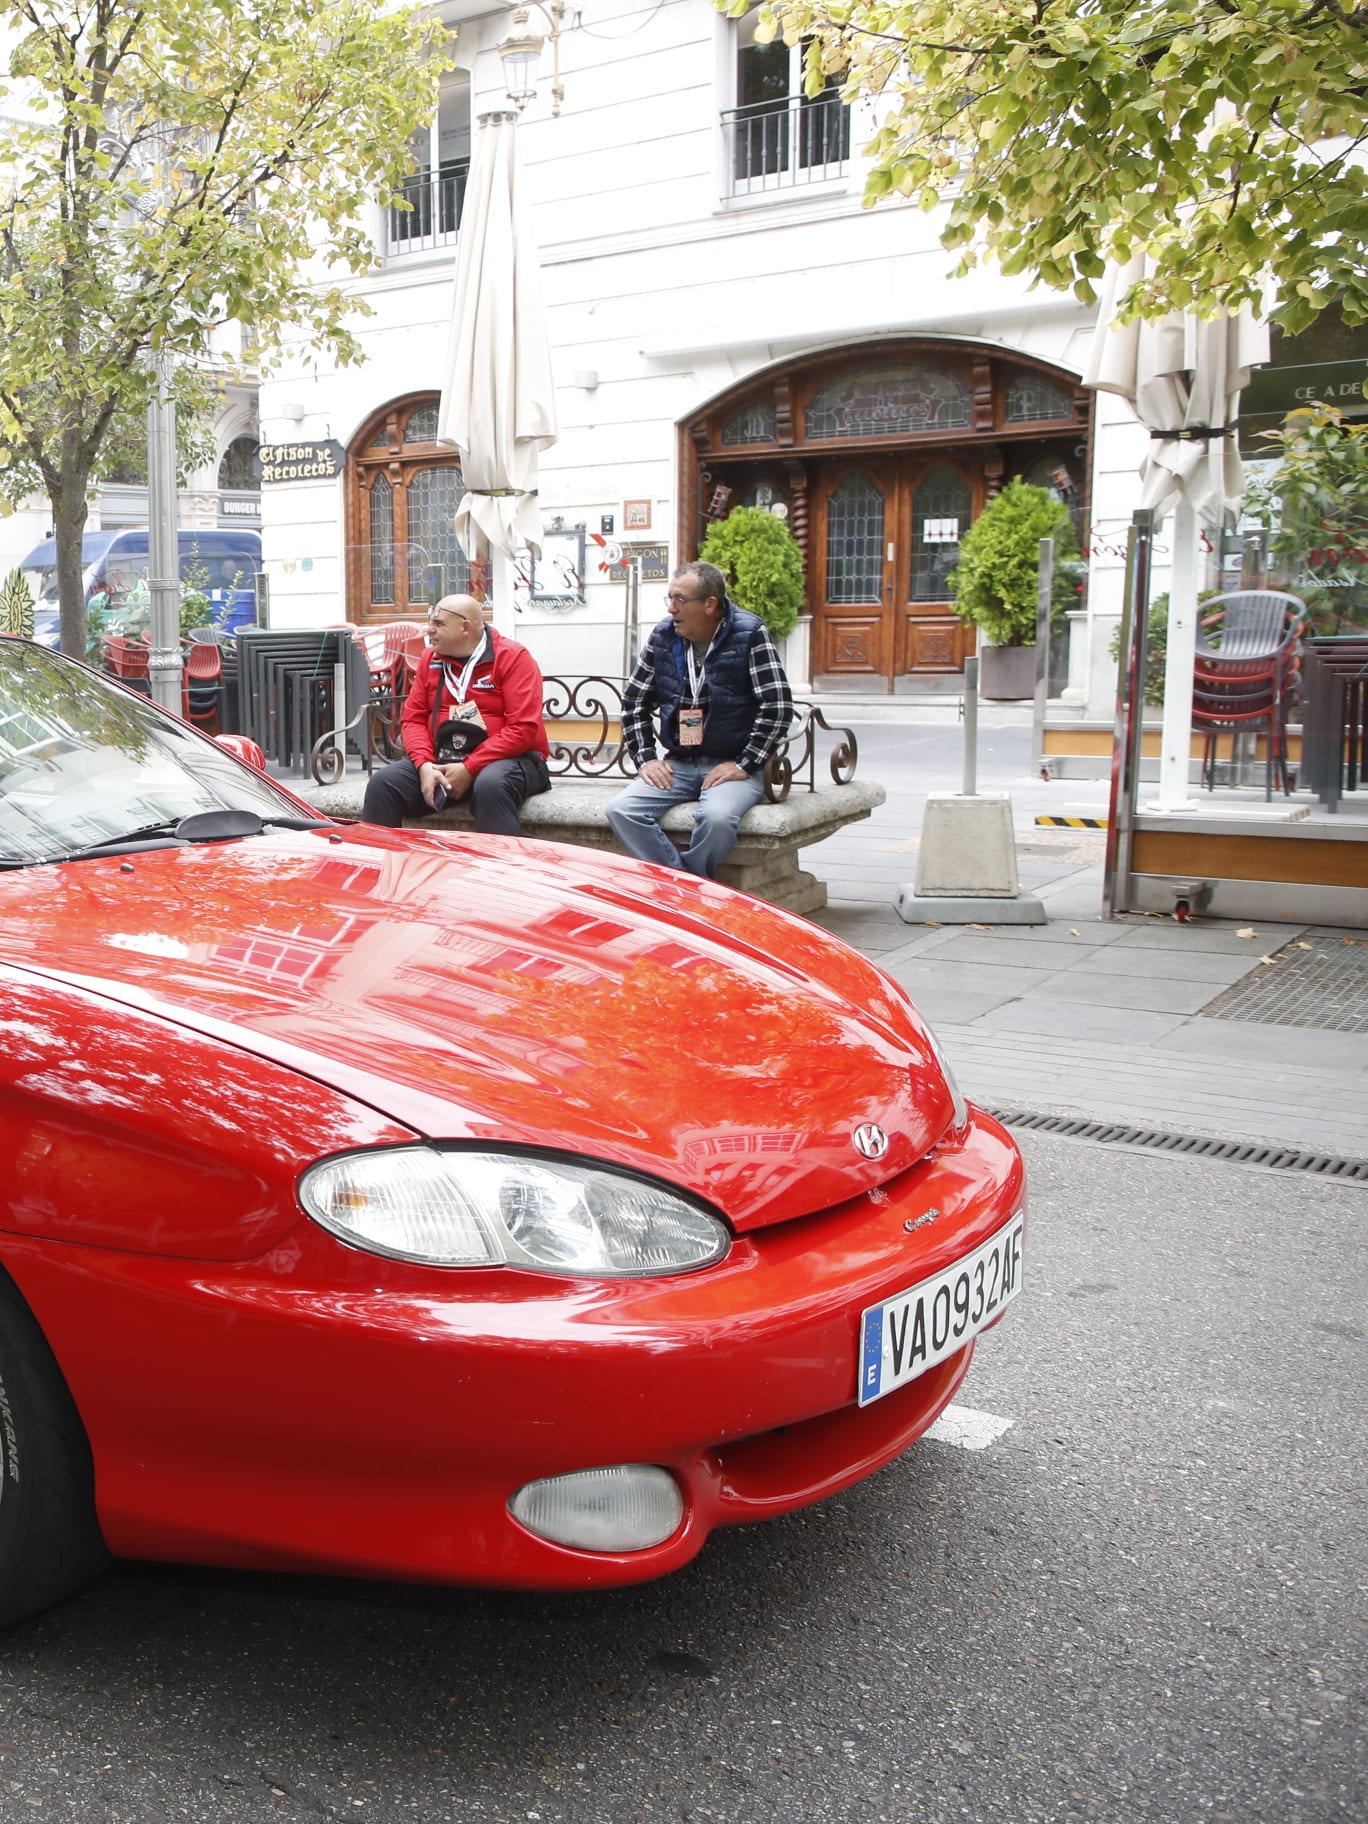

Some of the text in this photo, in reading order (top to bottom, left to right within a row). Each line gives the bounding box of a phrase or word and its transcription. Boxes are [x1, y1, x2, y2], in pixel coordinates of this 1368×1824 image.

[261, 460, 337, 482] Recoletos
[223, 501, 256, 515] BURGER
[867, 1364, 877, 1386] E
